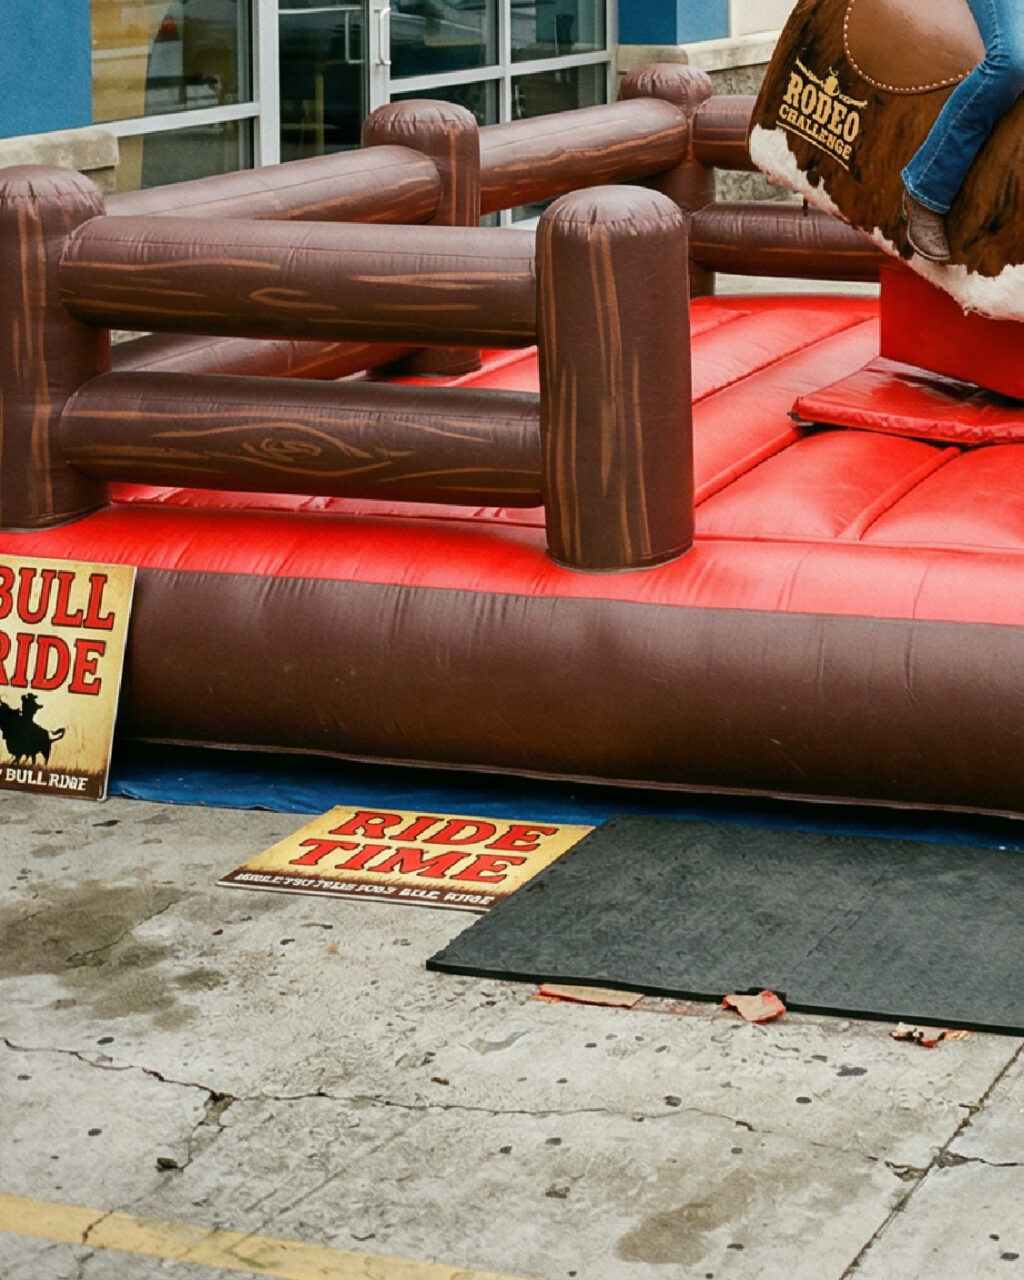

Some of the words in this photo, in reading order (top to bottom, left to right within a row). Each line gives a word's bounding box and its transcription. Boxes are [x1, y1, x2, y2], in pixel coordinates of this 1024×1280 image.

[782, 70, 860, 142] RODEO
[779, 104, 852, 160] CHALLENGE
[5, 767, 47, 786] BULL
[327, 809, 560, 852] RIDE
[288, 837, 528, 885] TIME
